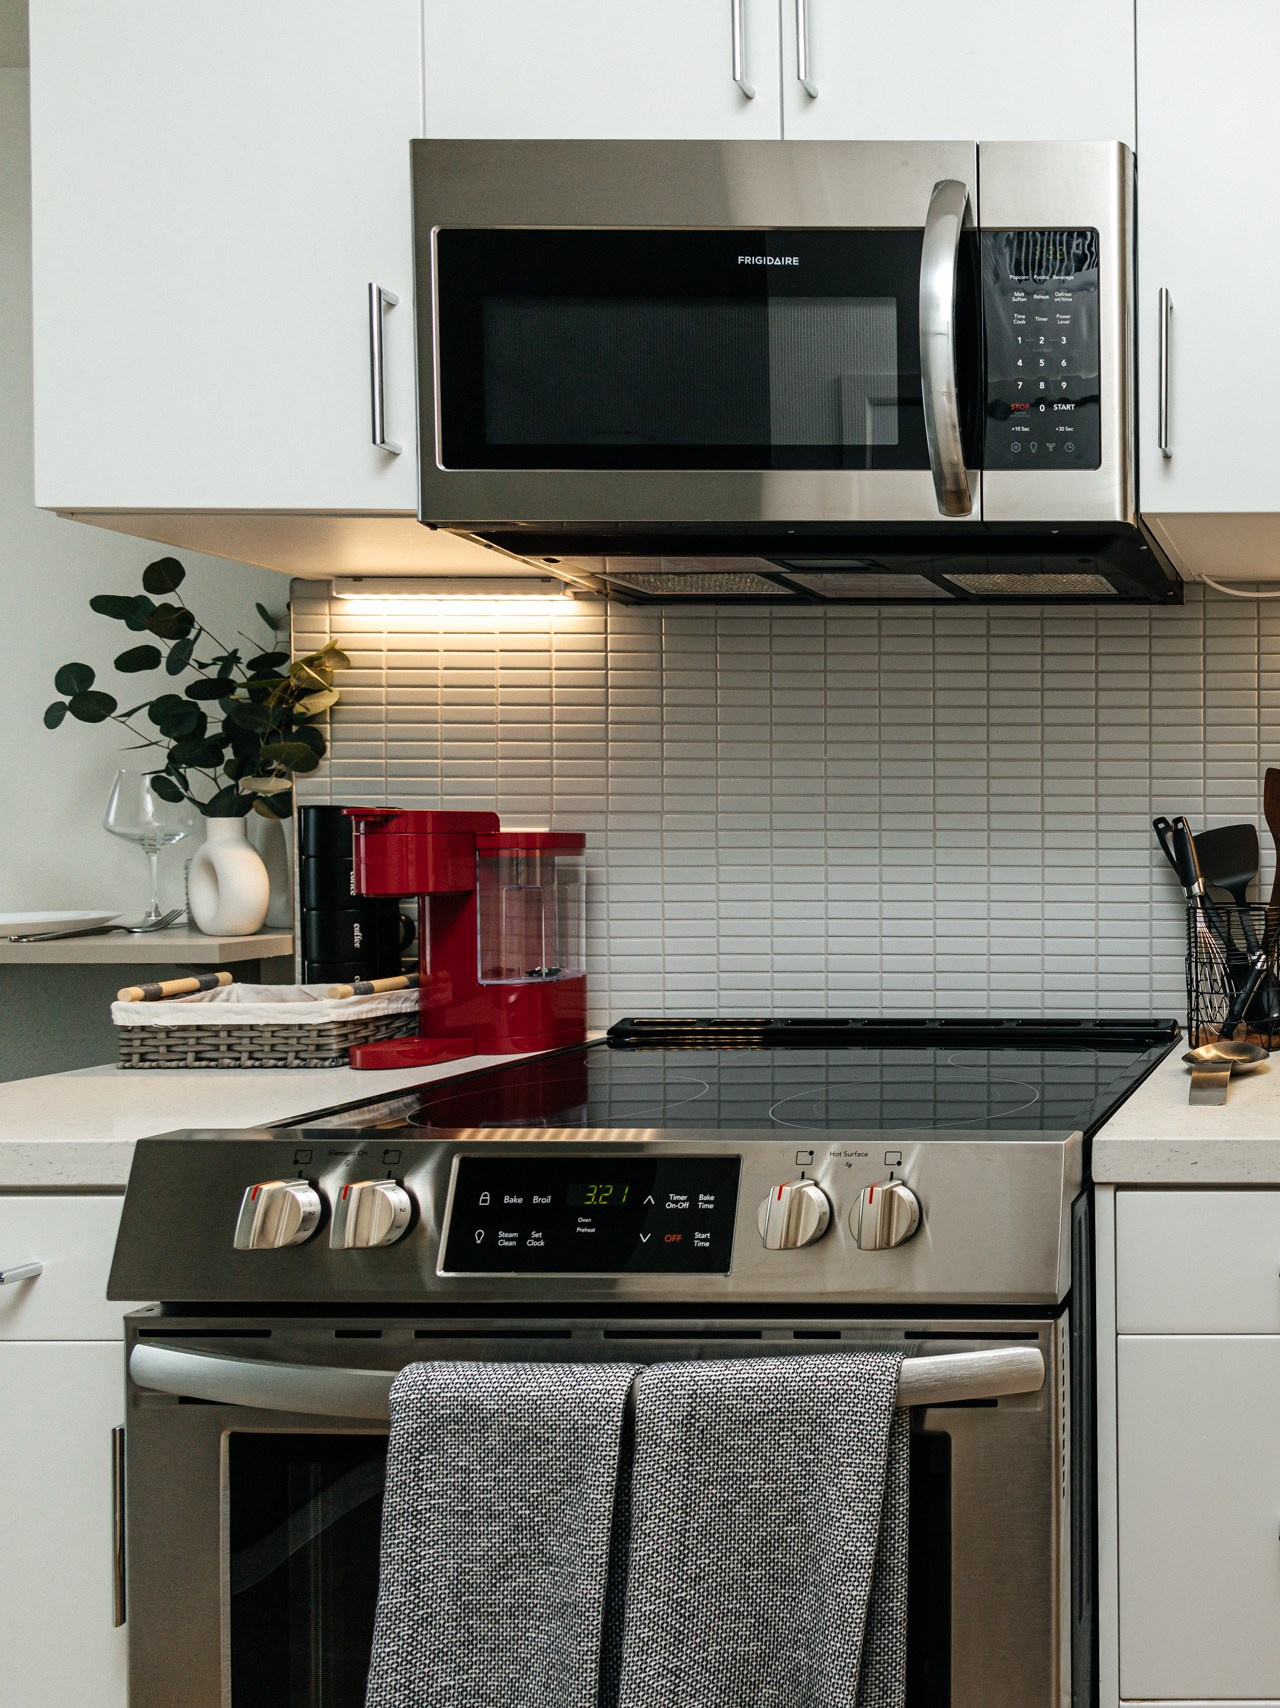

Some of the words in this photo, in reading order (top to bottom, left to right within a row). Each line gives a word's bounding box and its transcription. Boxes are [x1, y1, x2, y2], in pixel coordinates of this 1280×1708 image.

[738, 256, 799, 265] FRIGIDAIRE
[1039, 404, 1045, 412] 0
[354, 923, 362, 948] coffee
[584, 1184, 629, 1204] 3:21
[504, 1195, 523, 1204] Bake
[532, 1195, 551, 1204] Broil
[664, 1234, 683, 1242] OFF
